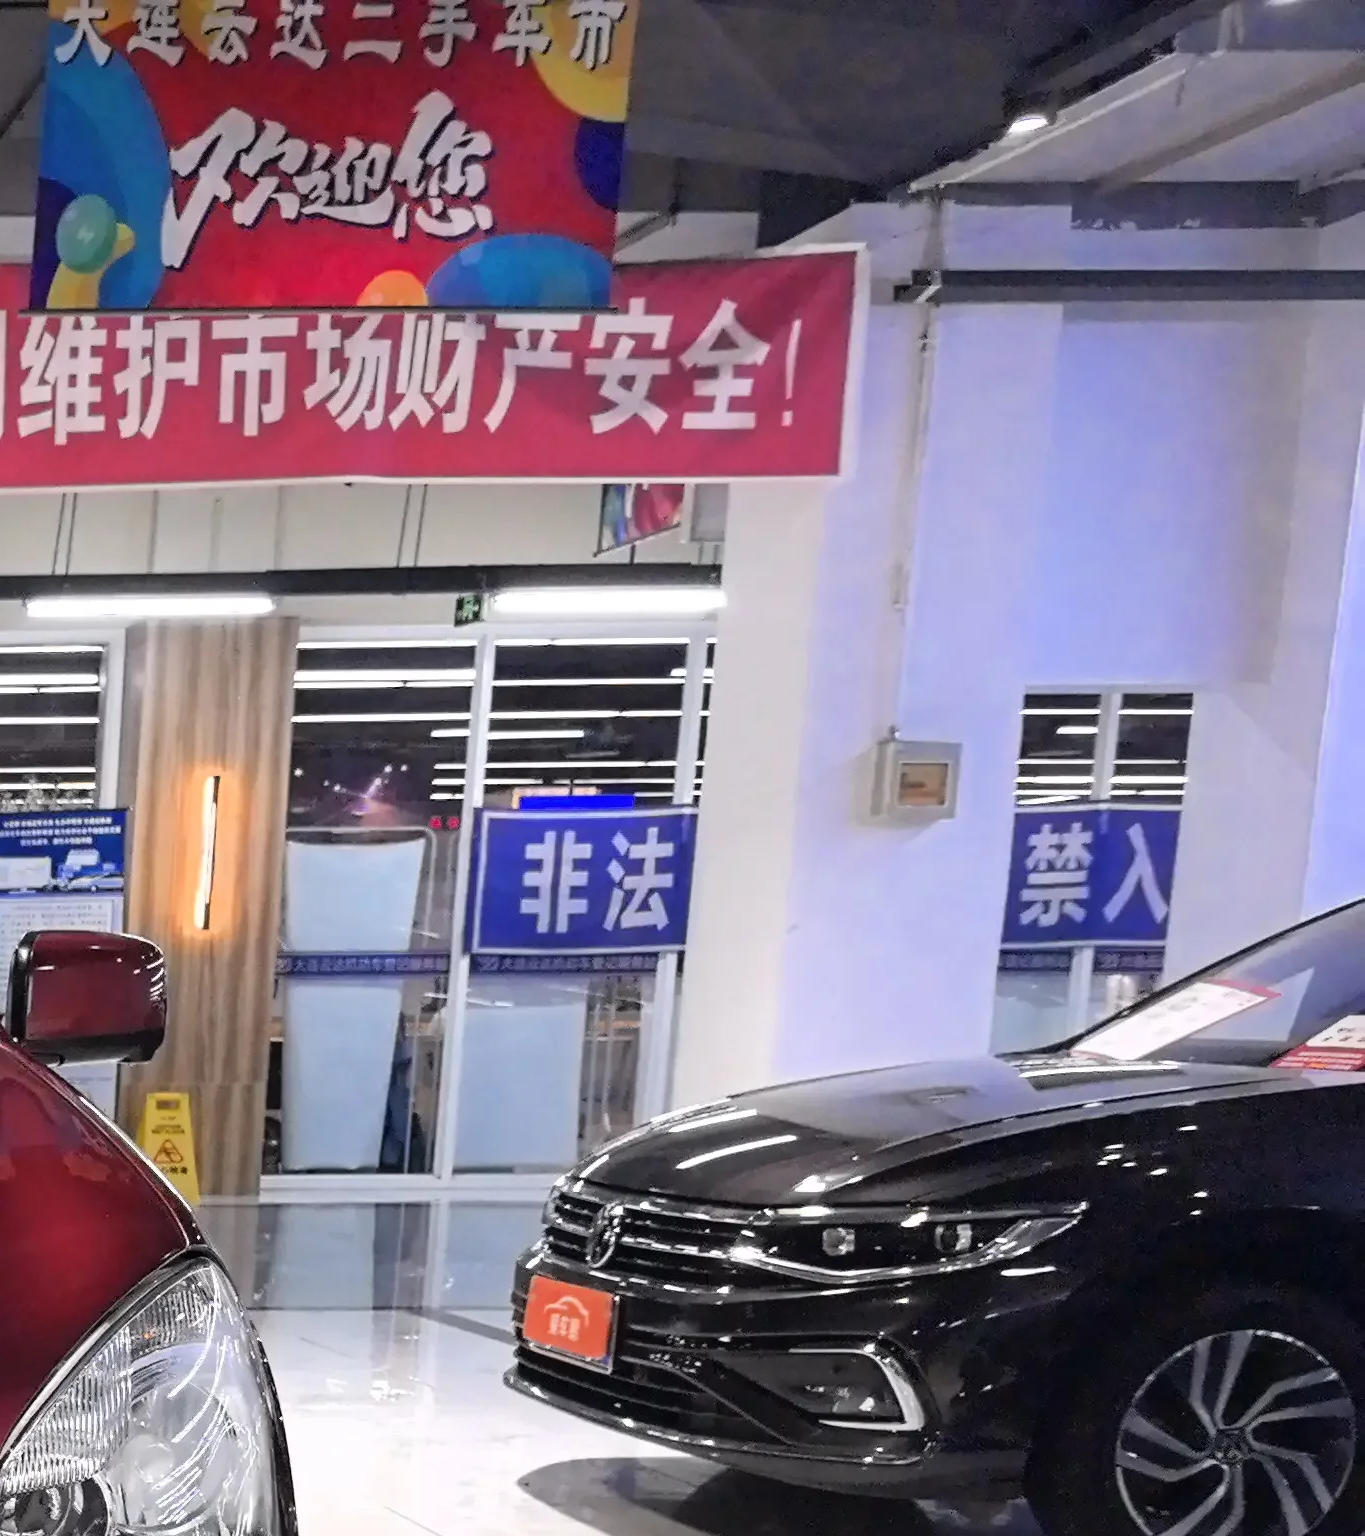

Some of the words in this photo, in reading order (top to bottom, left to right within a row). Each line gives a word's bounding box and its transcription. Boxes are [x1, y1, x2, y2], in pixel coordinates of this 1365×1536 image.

[54, 0, 626, 70] 大连云达二手车市
[161, 88, 496, 270] 欢迎您
[519, 826, 675, 934] 非法
[1018, 823, 1170, 928] 禁入
